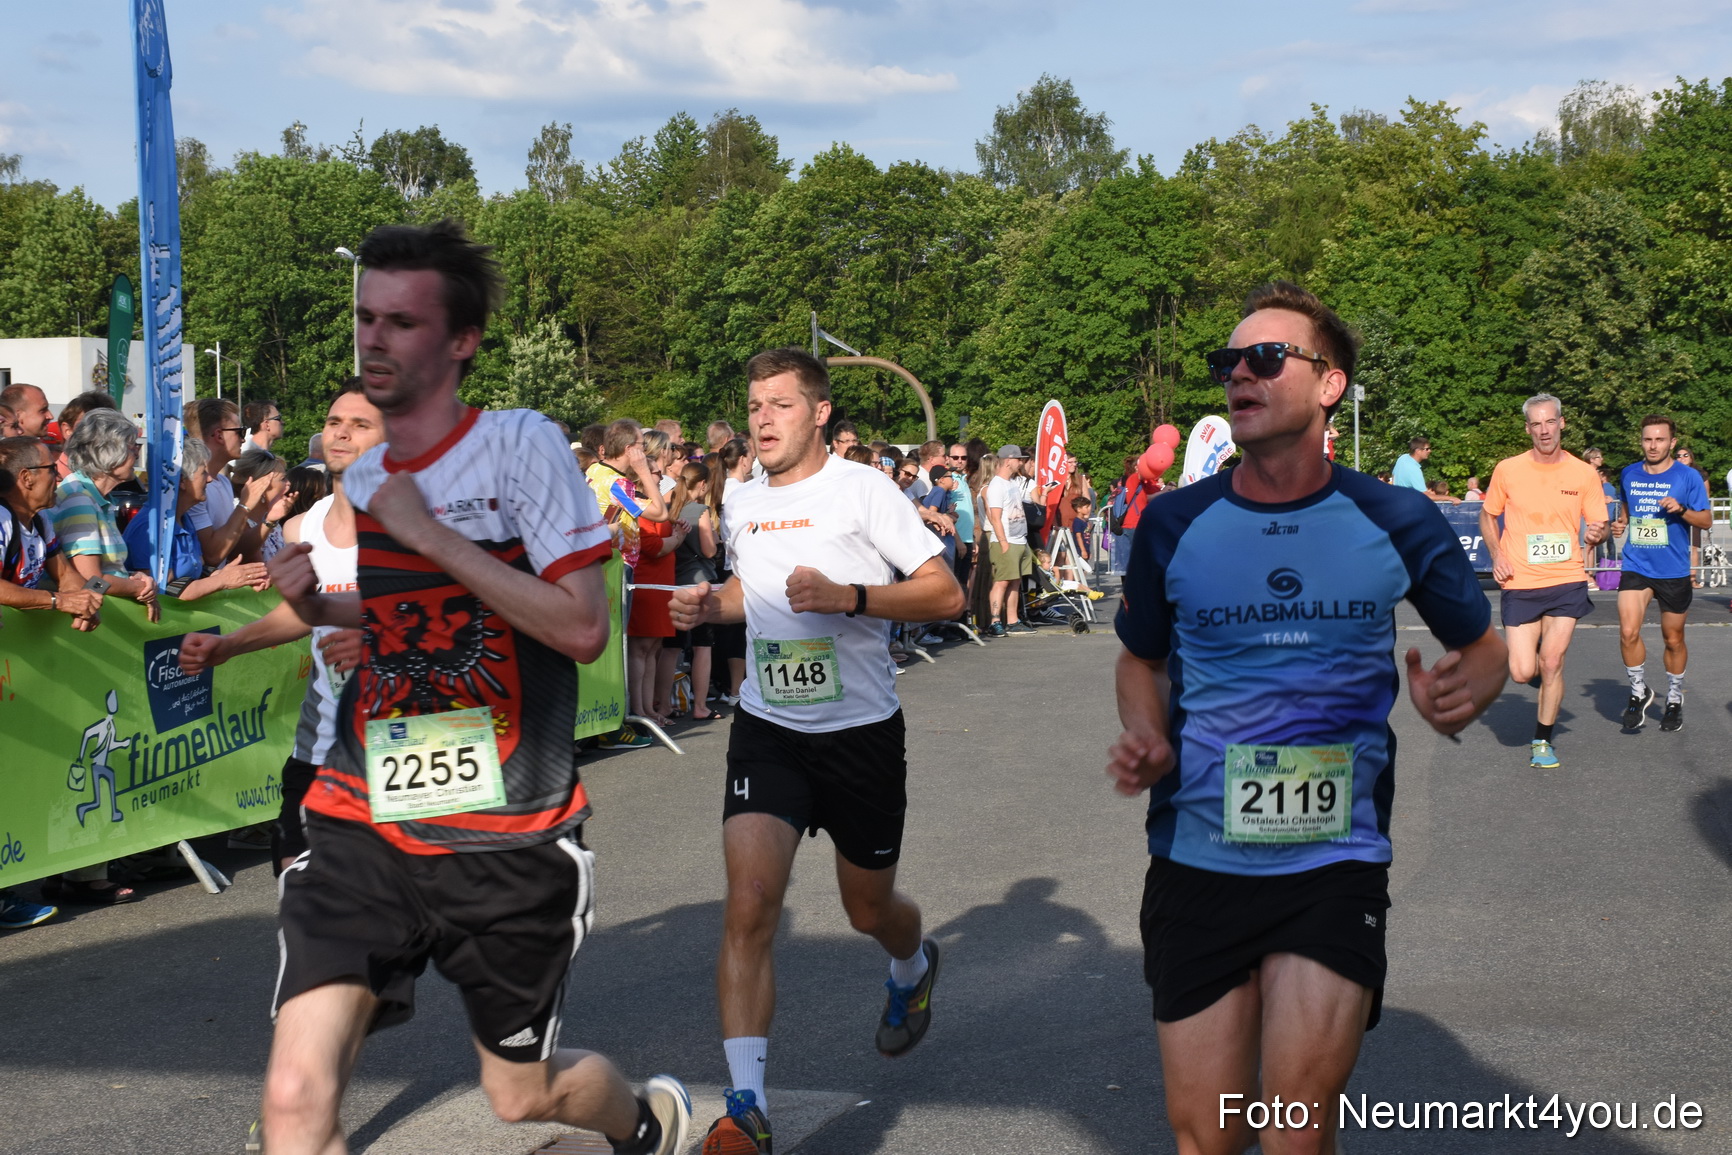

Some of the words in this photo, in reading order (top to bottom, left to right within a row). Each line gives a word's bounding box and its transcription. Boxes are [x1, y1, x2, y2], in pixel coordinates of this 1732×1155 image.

[1630, 489, 1669, 497] Hausverkauf
[1638, 497, 1657, 505] richtig
[1635, 505, 1660, 513] LAUFEN
[760, 518, 815, 532] KLEBL
[1636, 527, 1658, 538] 728
[1532, 543, 1566, 556] 2310
[1196, 601, 1377, 628] SCHABMÜLLER
[1262, 631, 1310, 646] TEAM
[764, 661, 827, 687] 1148
[163, 673, 200, 691] AUTOMOBILE
[775, 687, 795, 695] Braun
[796, 686, 817, 694] Daniel
[129, 687, 273, 786] firmenlauf
[382, 745, 479, 792] 2255
[131, 771, 201, 812] neumarkt
[236, 774, 285, 810] www.fir
[436, 783, 484, 798] Christian
[734, 777, 750, 800] 4
[1240, 780, 1337, 815] 2119
[1242, 815, 1290, 827] Ostalecki
[1291, 814, 1337, 827] Christoph
